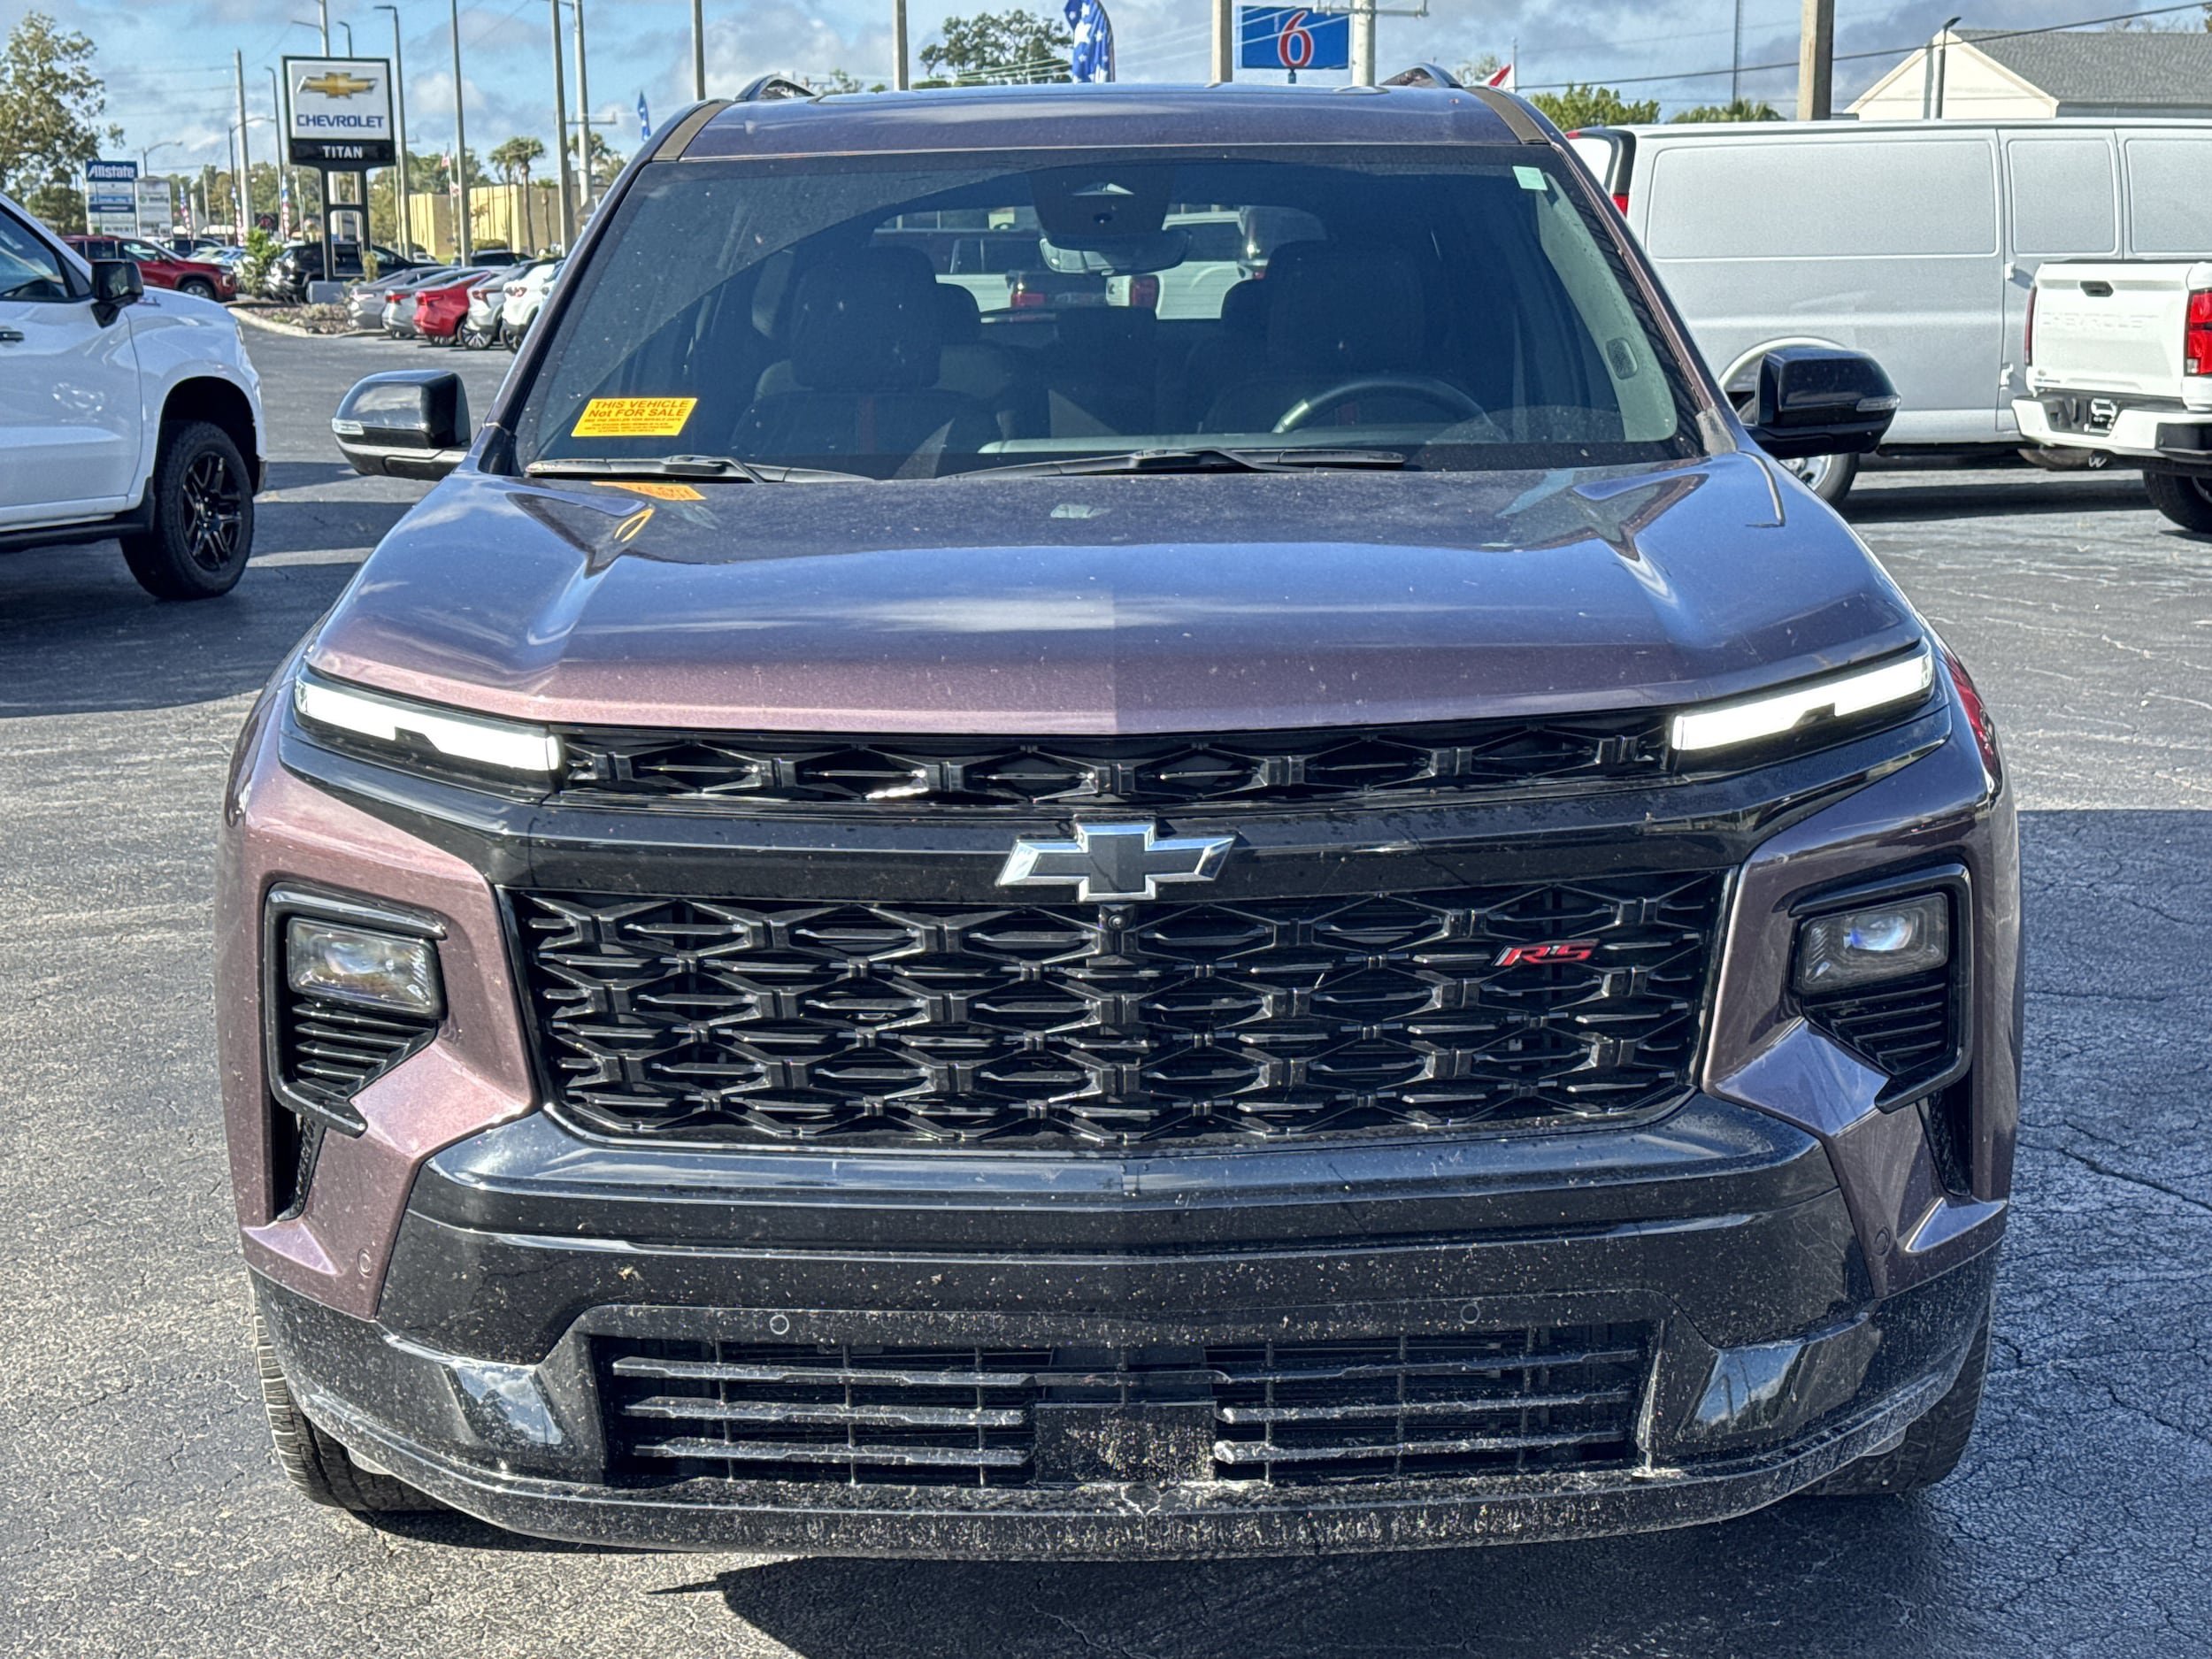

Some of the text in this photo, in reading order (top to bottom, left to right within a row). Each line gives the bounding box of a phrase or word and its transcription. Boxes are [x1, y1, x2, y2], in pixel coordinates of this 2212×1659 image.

[1277, 10, 1315, 67] 6
[296, 114, 384, 128] CHEVROLET
[322, 145, 364, 159] TITAN
[88, 165, 134, 178] Allstate
[1493, 941, 1594, 966] RS
